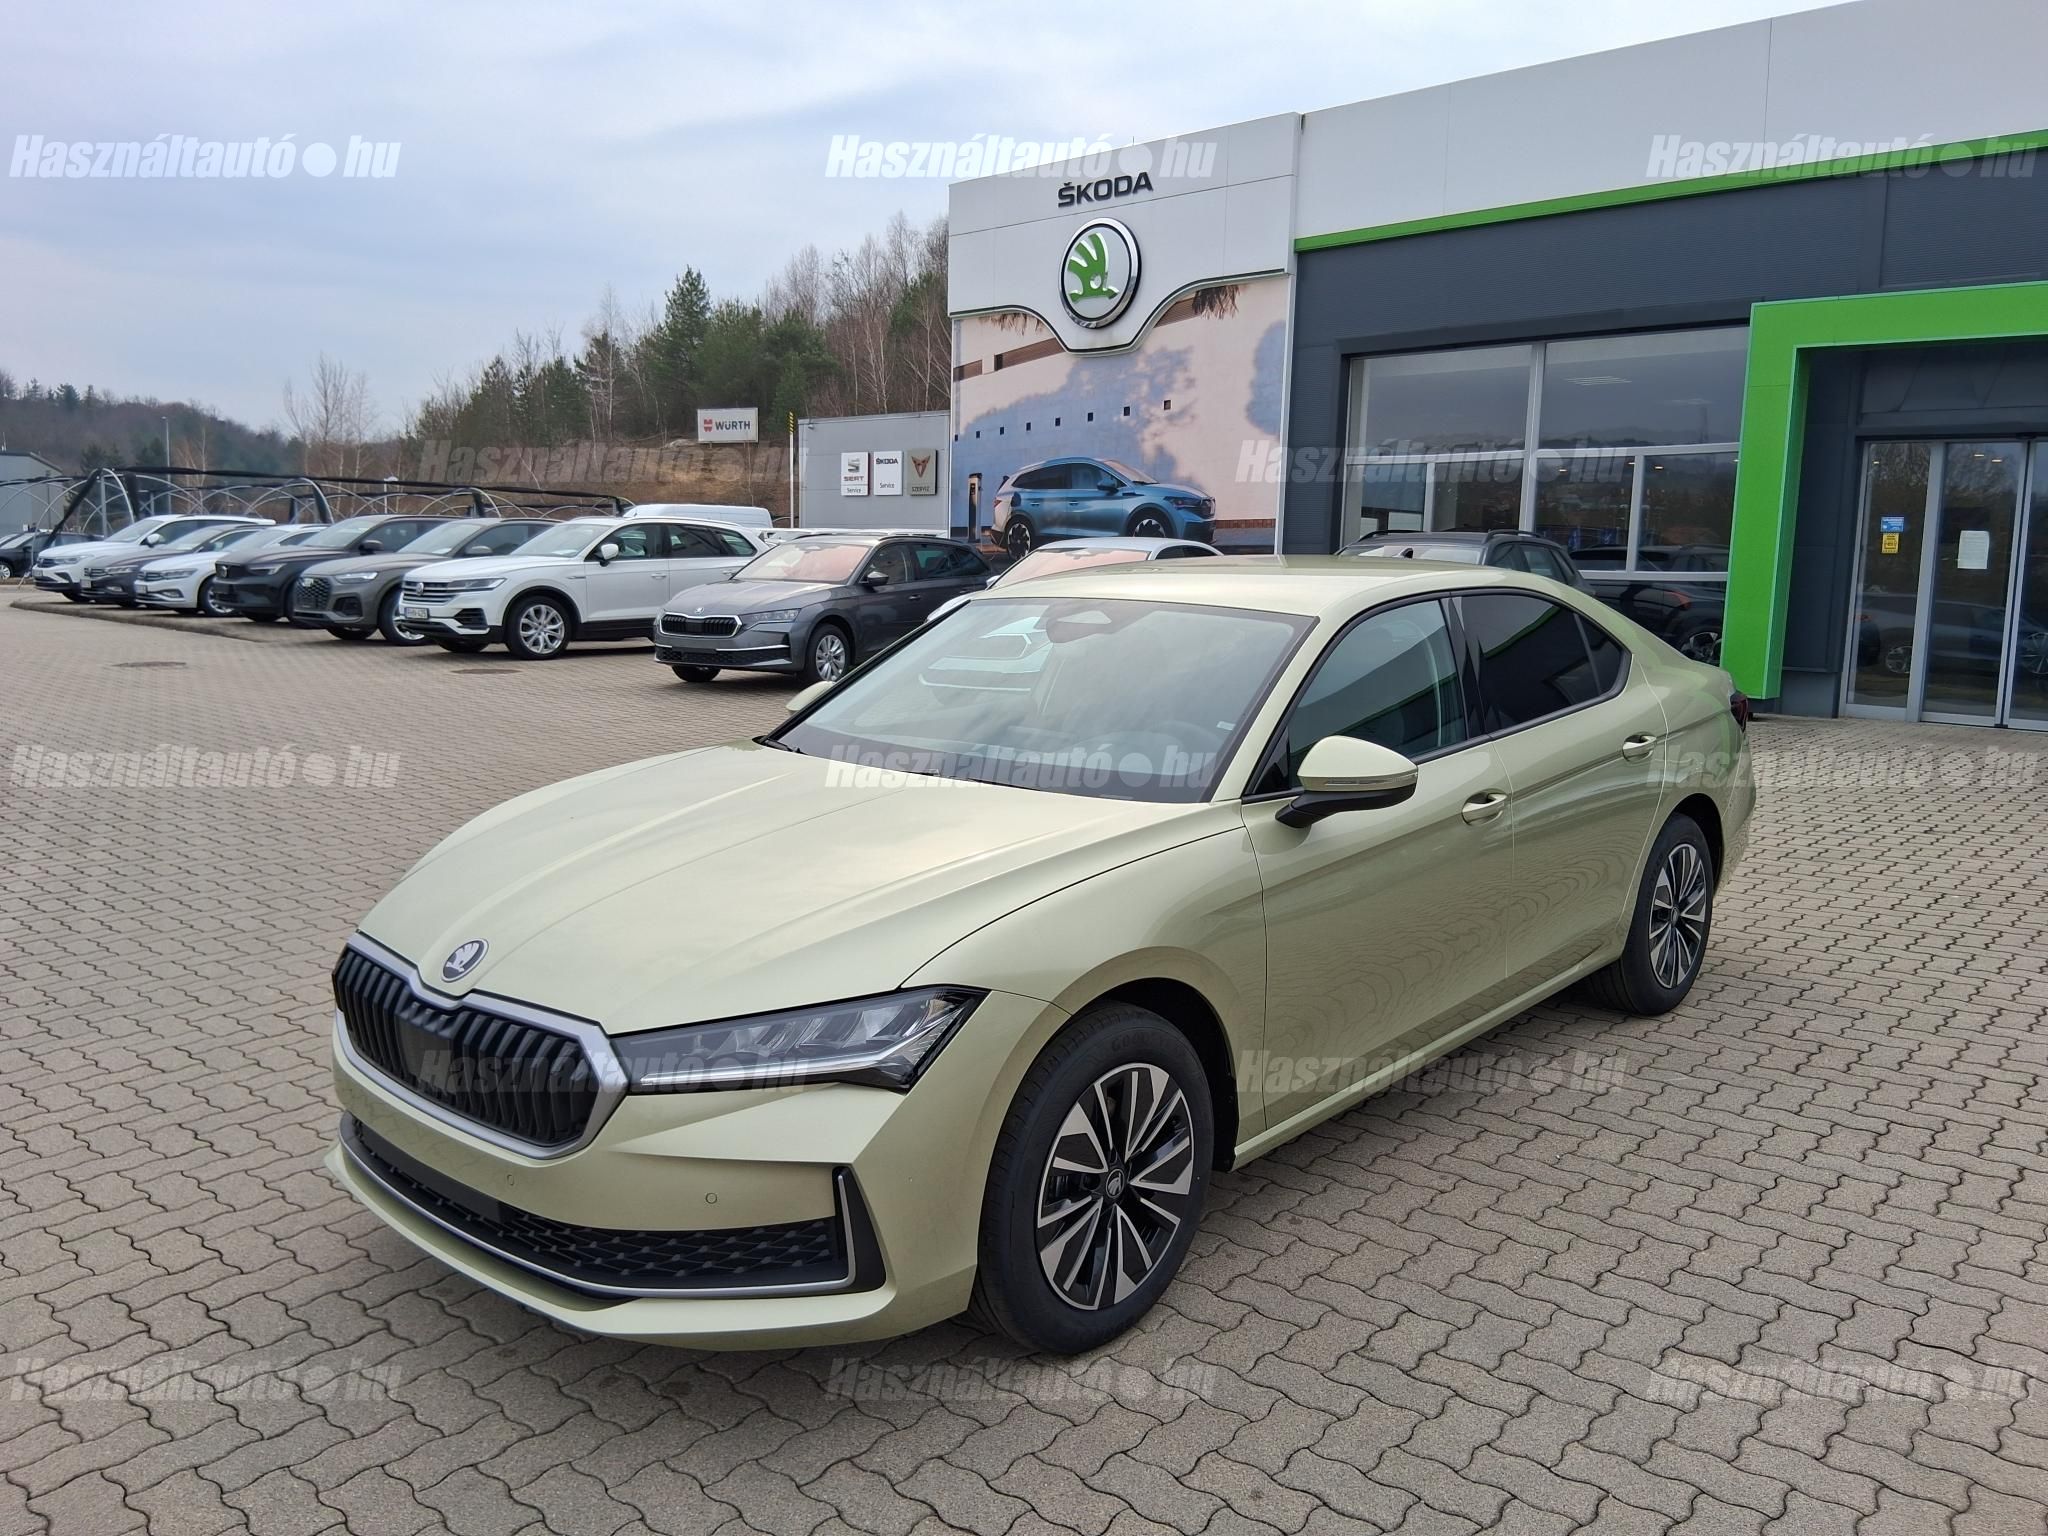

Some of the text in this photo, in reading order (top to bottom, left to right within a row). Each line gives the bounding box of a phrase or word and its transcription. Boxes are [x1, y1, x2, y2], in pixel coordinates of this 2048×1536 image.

[1058, 171, 1154, 208] ŠKODA
[715, 420, 751, 431] WÜRTH
[875, 457, 899, 465] ŠKODA
